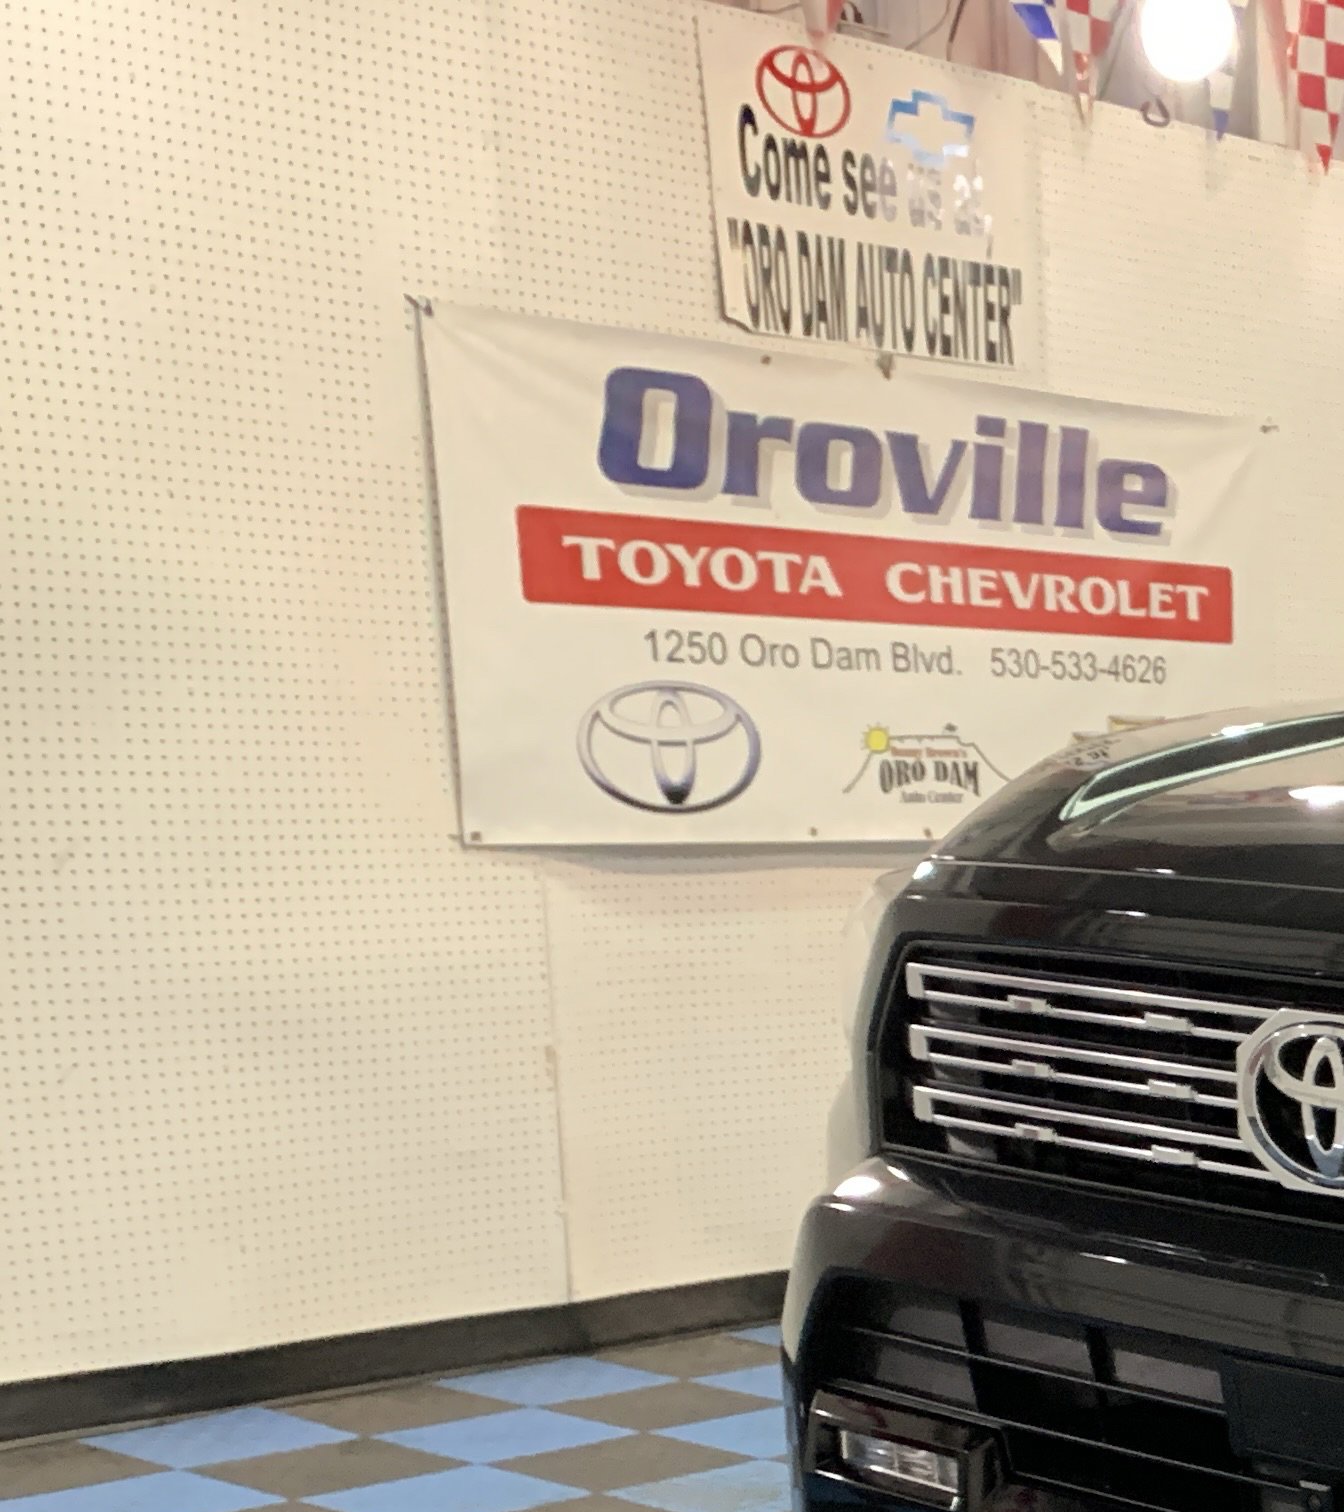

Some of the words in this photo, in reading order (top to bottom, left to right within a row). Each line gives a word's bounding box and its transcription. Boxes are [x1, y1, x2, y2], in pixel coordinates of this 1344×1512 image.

[738, 103, 832, 211] Come
[841, 148, 897, 223] see
[796, 229, 849, 342] DAM
[856, 241, 916, 353] AUTO
[923, 252, 1023, 366] CENTER"
[598, 366, 1168, 536] Oroville
[561, 534, 843, 599] TOYOTA
[885, 561, 1211, 623] CHEVROLET
[644, 629, 728, 666] 1250
[739, 633, 800, 669] Oro
[811, 637, 881, 673] Dam
[891, 641, 963, 677] Blvd.
[989, 648, 1168, 686] 530-533-4626
[878, 759, 926, 795] ORO
[933, 760, 981, 798] DAM
